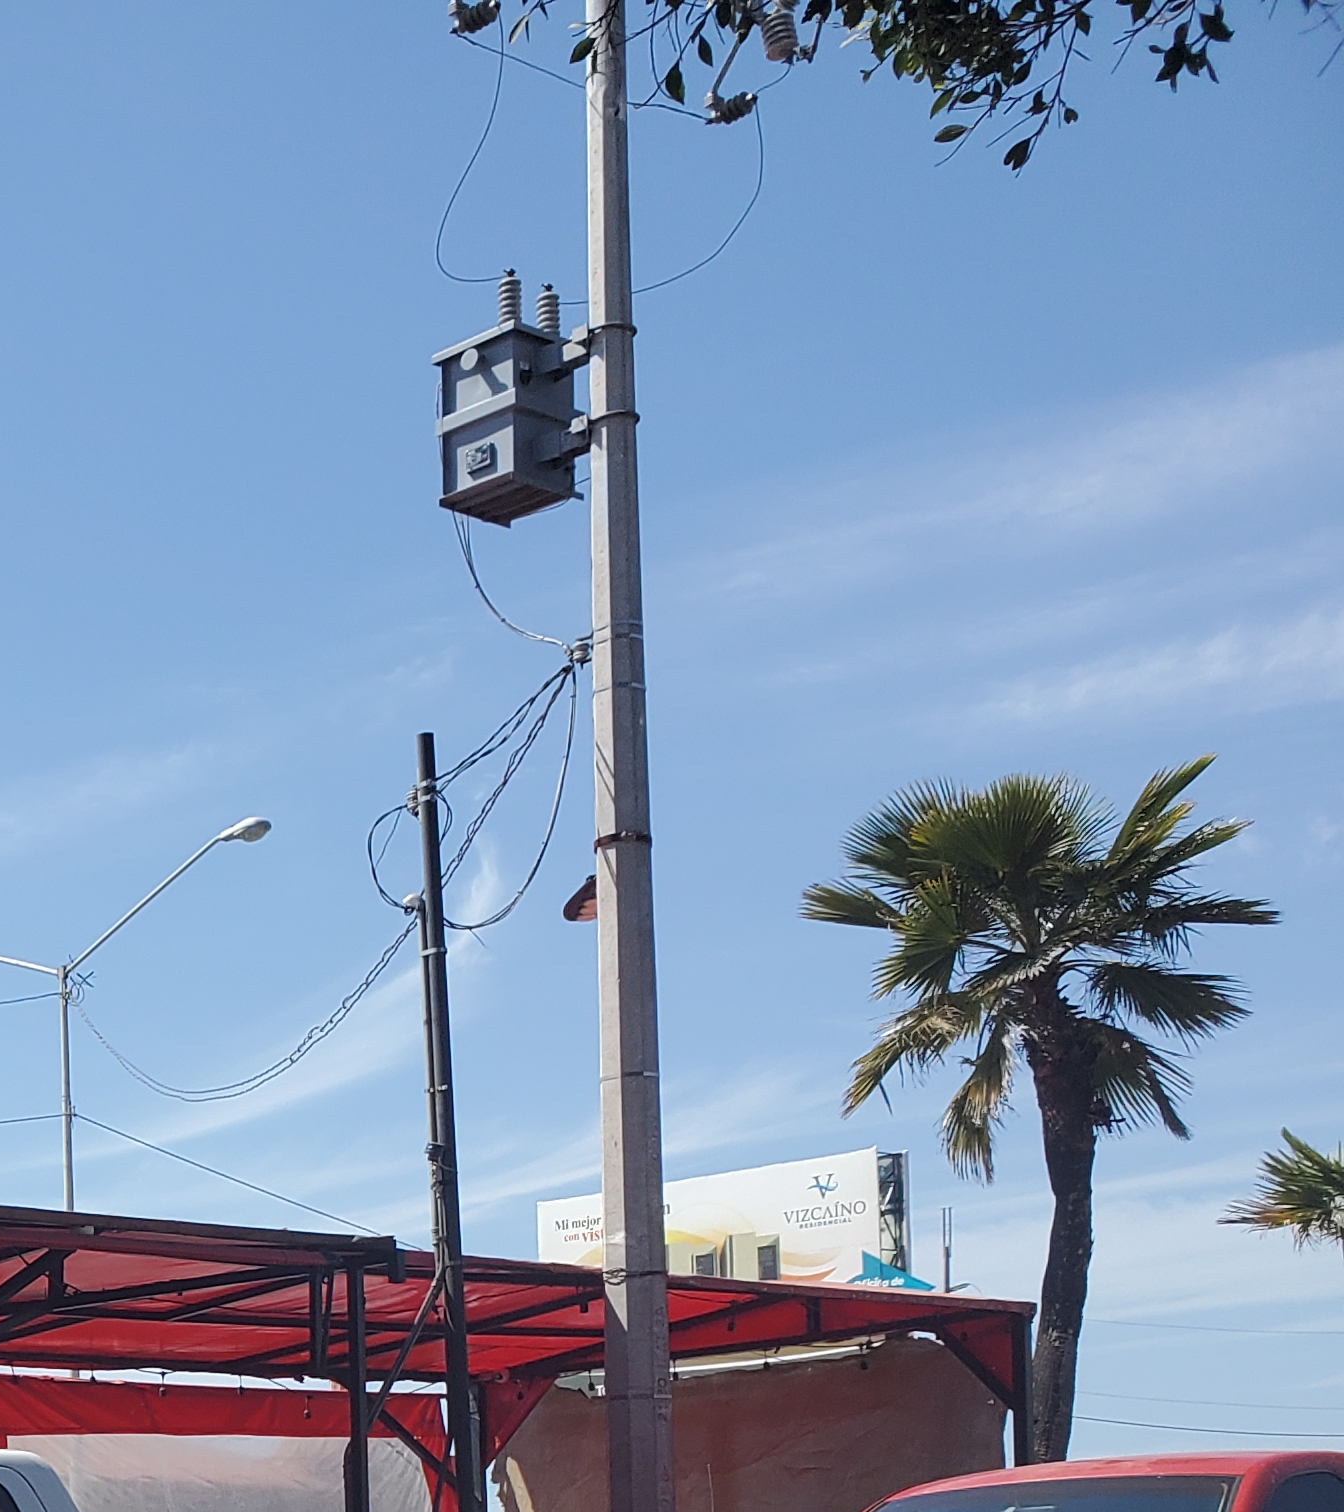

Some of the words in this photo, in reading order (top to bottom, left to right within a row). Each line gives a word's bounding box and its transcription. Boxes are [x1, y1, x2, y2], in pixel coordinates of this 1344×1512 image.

[783, 1200, 866, 1224] VIZCAÍNO
[554, 1219, 569, 1232] Mi
[571, 1215, 602, 1230] mejor
[798, 1217, 853, 1229] RESIDENCIAL
[563, 1233, 580, 1242] con
